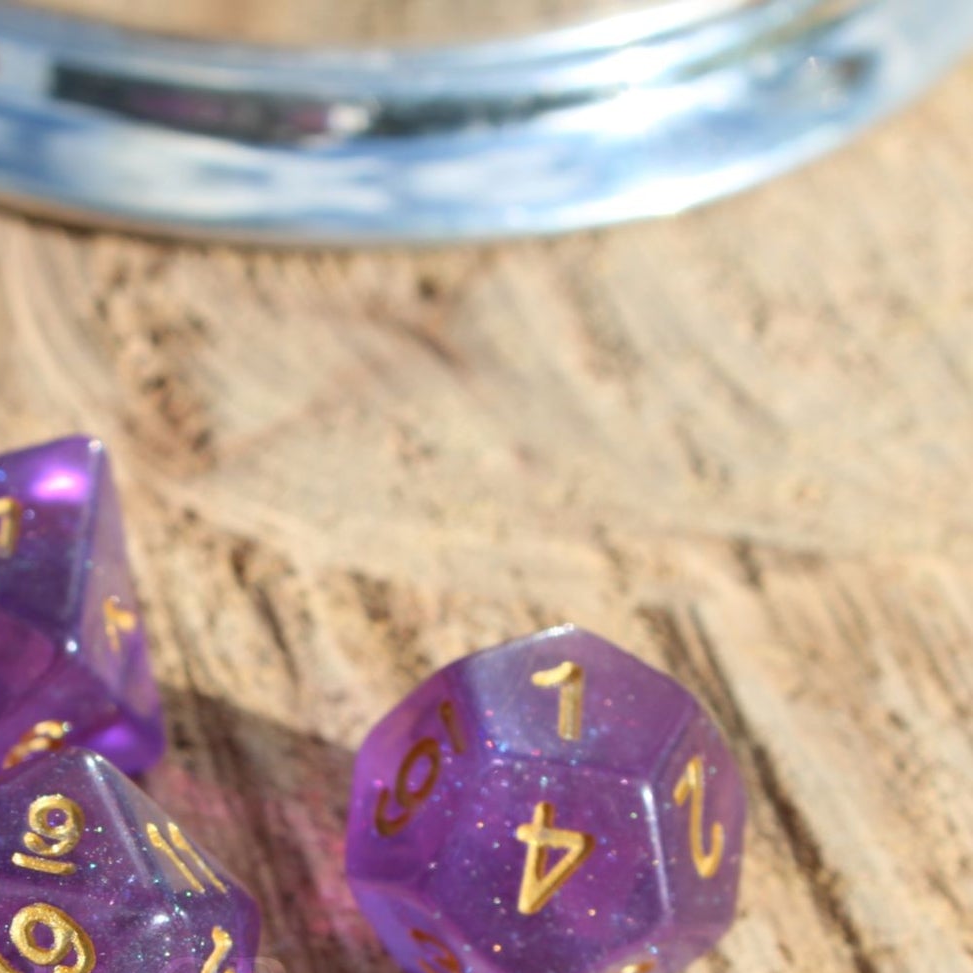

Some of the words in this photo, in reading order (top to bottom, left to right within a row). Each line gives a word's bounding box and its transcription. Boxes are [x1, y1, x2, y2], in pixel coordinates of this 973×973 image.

[531, 660, 584, 742] 1
[515, 802, 596, 916] 4
[673, 757, 725, 878] 2
